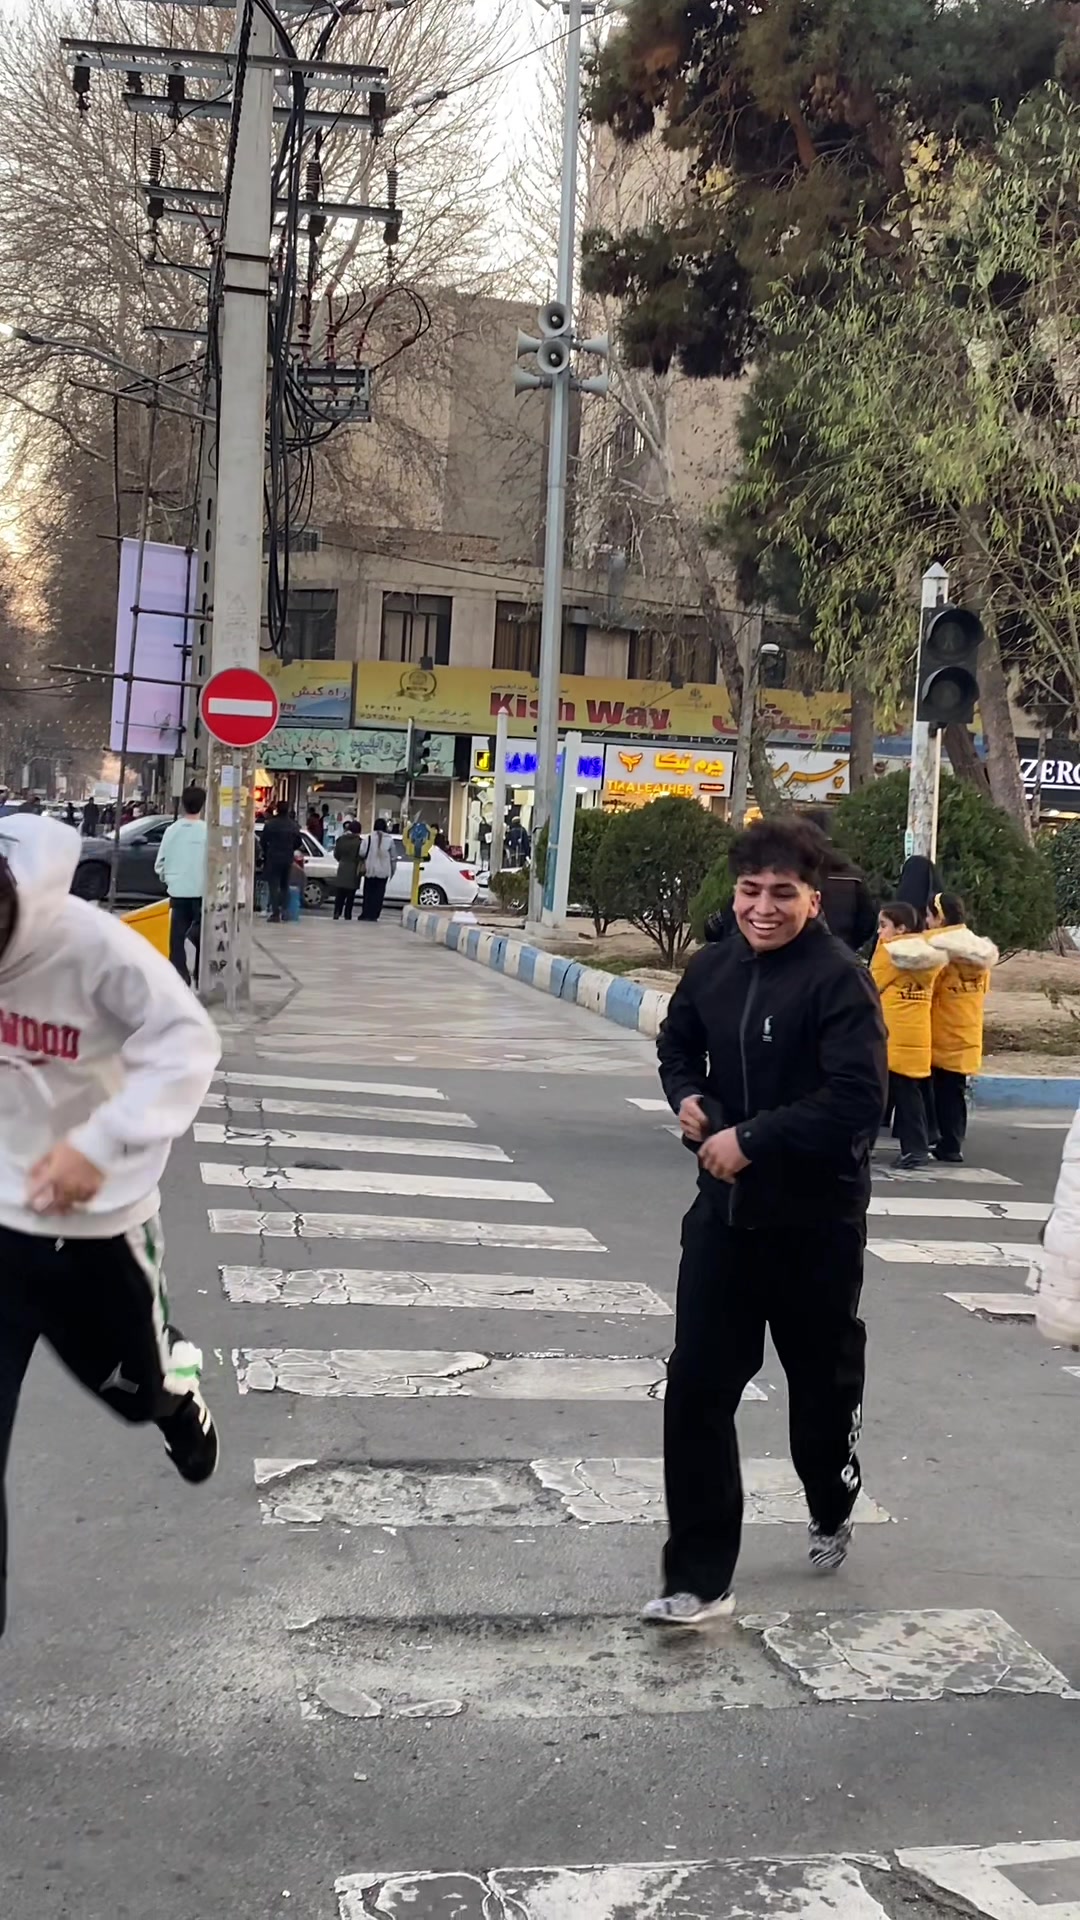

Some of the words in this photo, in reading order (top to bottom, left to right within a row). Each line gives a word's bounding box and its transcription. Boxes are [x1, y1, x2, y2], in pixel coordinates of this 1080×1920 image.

[291, 686, 324, 699] کیش
[327, 687, 347, 700] راه
[489, 692, 576, 722] Kish
[586, 699, 671, 730] Way
[655, 751, 692, 776] تیکا
[693, 758, 725, 776] چرم
[607, 780, 635, 793] TIKA
[637, 782, 695, 796] LEATHER
